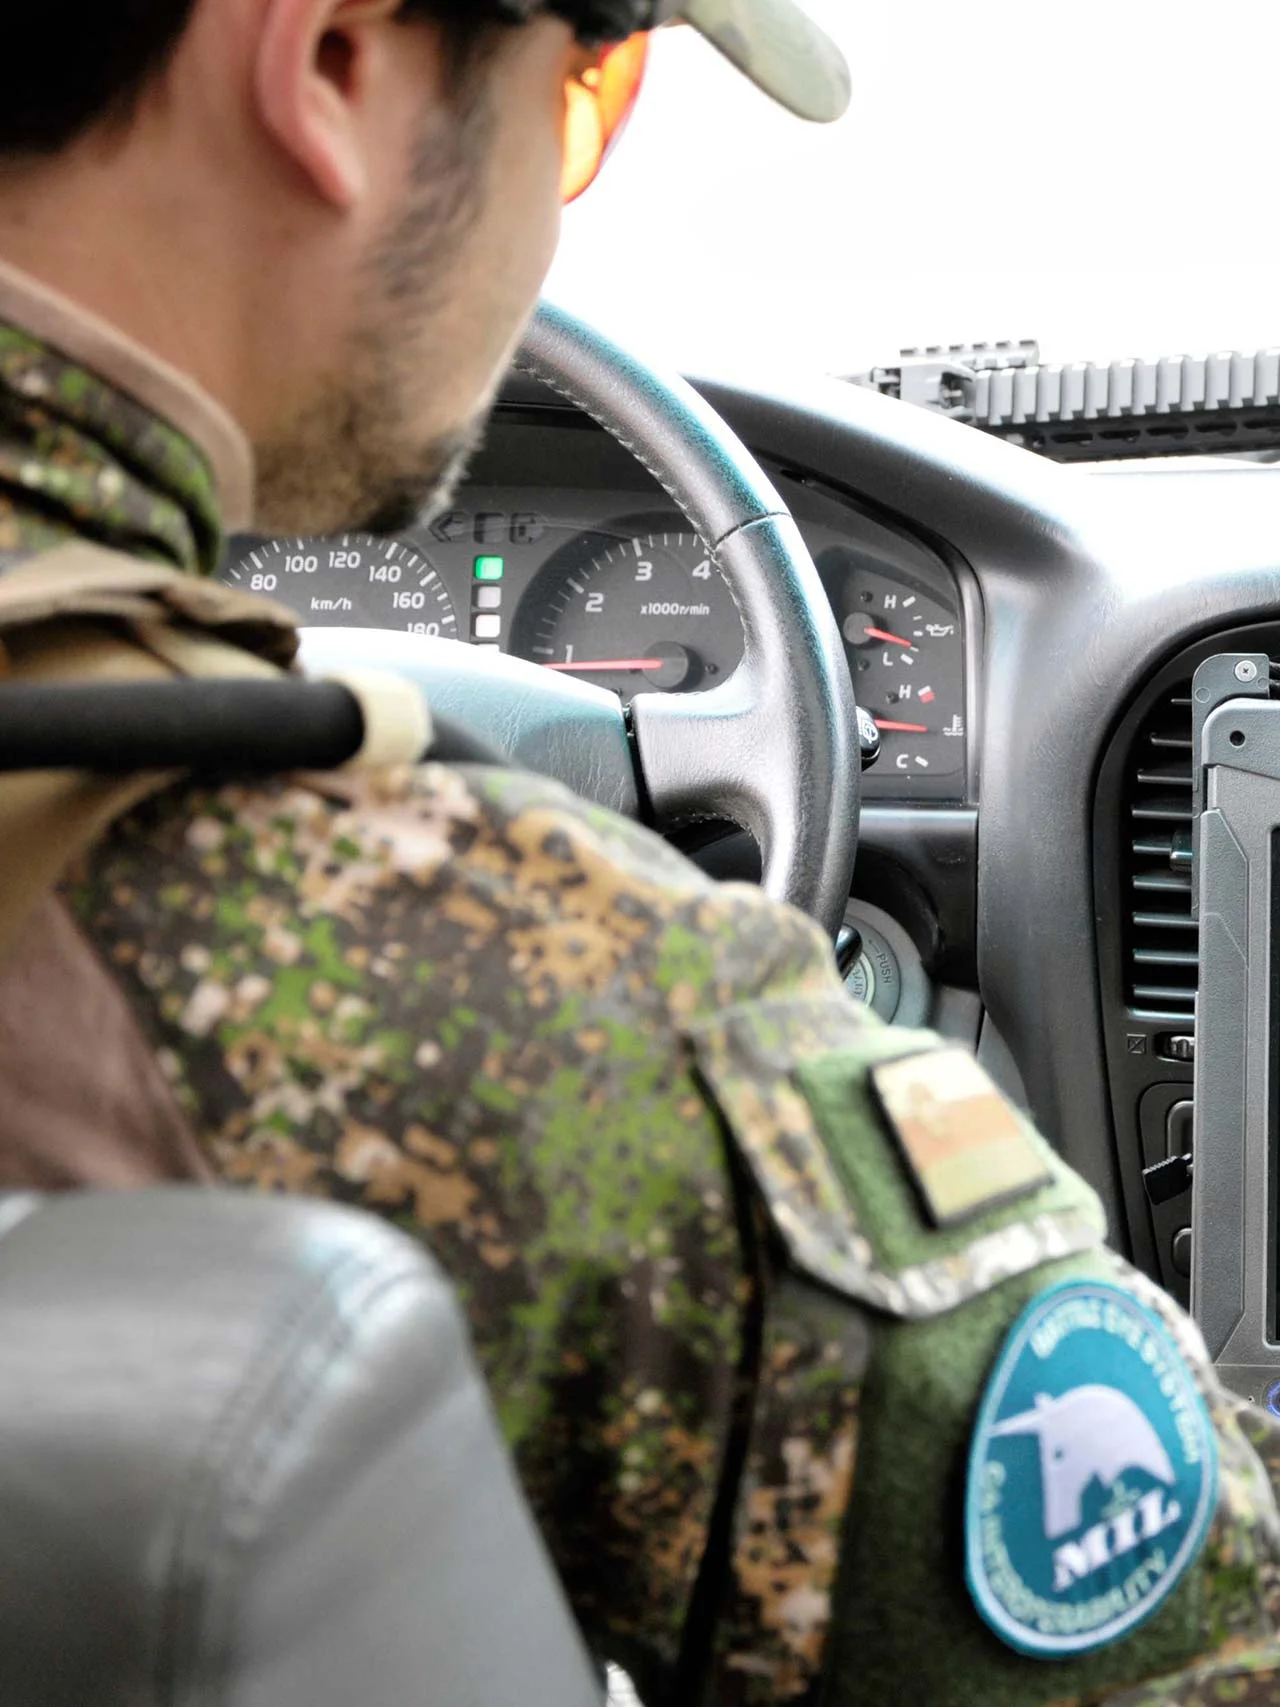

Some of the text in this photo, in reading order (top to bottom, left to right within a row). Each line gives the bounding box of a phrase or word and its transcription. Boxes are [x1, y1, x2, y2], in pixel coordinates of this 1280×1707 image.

[284, 555, 318, 573] 100
[328, 551, 361, 569] 120
[692, 558, 713, 580] 4
[369, 565, 402, 583] 140
[635, 561, 653, 581] 3
[250, 573, 277, 591] 80
[310, 597, 352, 610] km/h
[392, 591, 425, 609] 160
[585, 592, 604, 613] 2
[640, 602, 710, 615] x1000r/min
[884, 595, 897, 609] H
[562, 644, 575, 665] 1
[882, 651, 894, 667] L
[898, 684, 912, 699] H
[896, 753, 909, 769] C
[877, 953, 893, 984] PUSH
[1053, 1489, 1181, 1593] MIL
